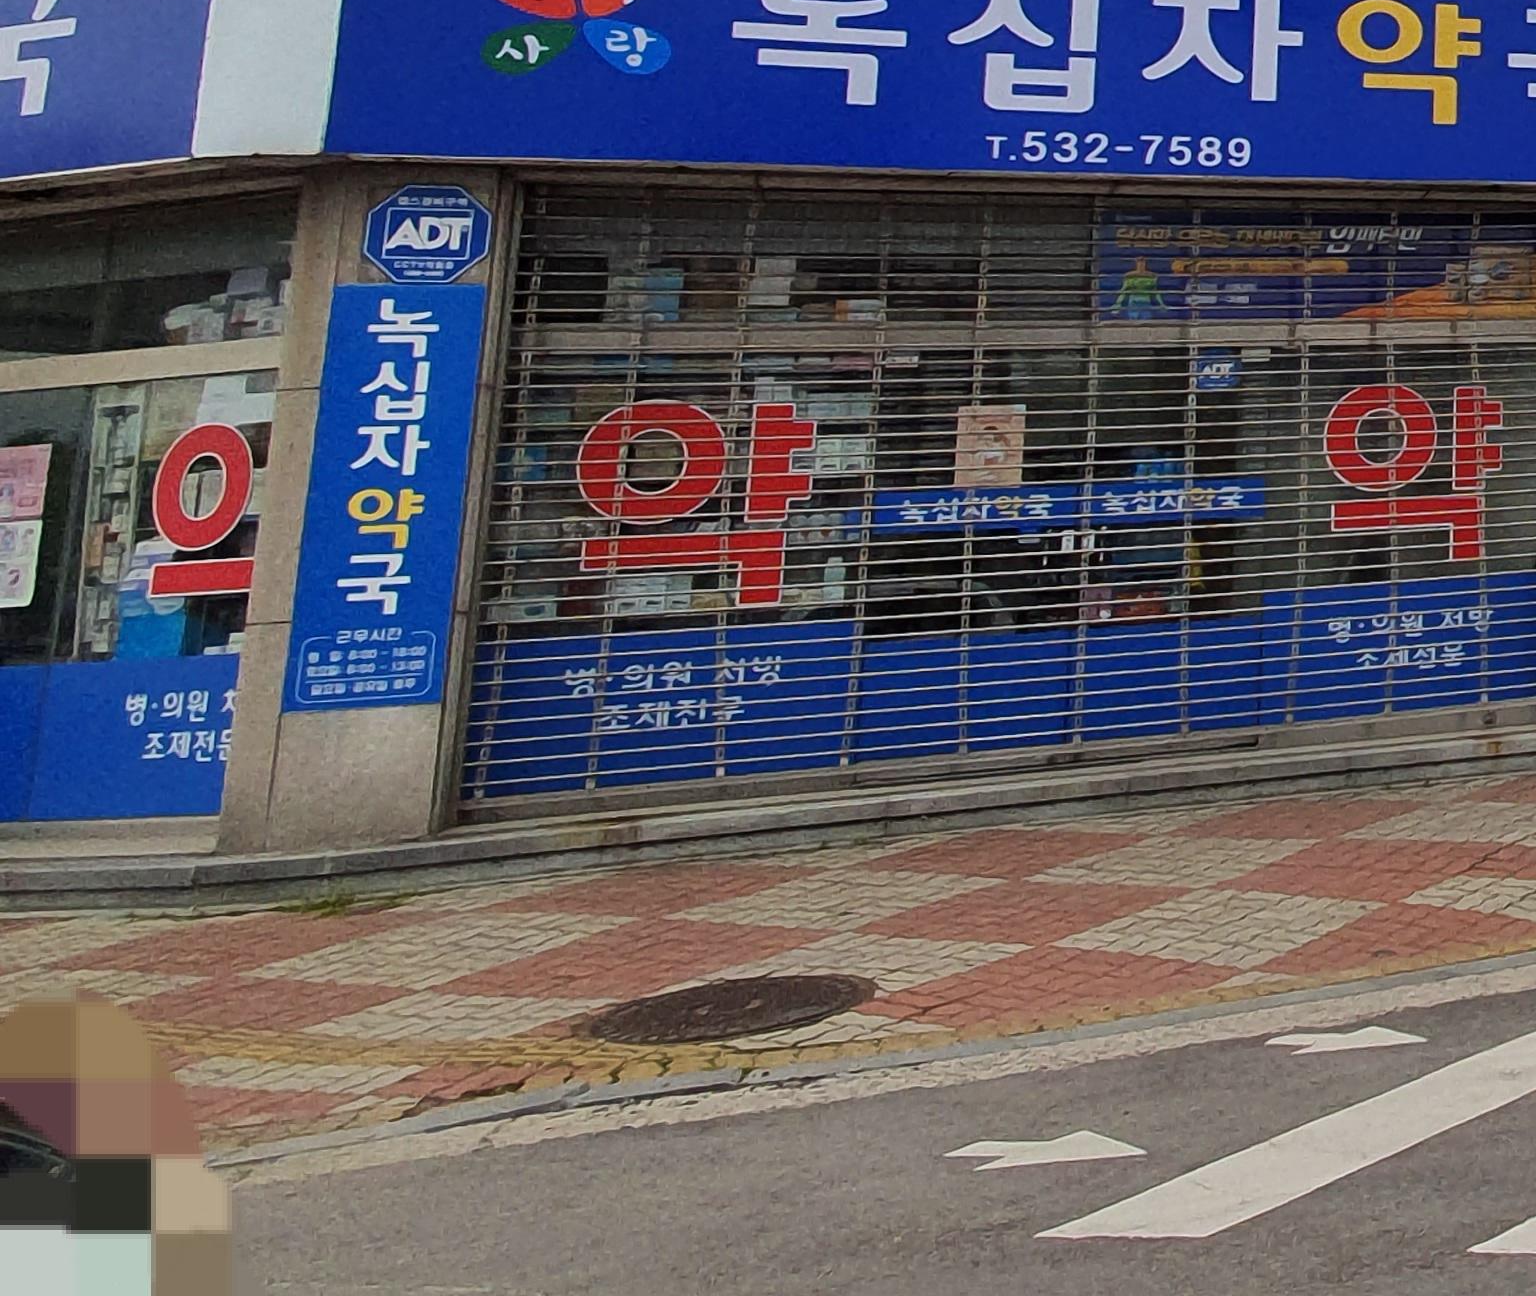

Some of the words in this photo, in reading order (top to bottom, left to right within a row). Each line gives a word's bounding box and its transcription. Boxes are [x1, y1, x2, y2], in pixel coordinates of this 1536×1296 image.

[385, 216, 472, 250] ADT
[337, 298, 441, 616] 녹십자약국
[577, 398, 818, 608] 약
[1324, 383, 1503, 562] 약
[125, 689, 210, 727] 병·의원
